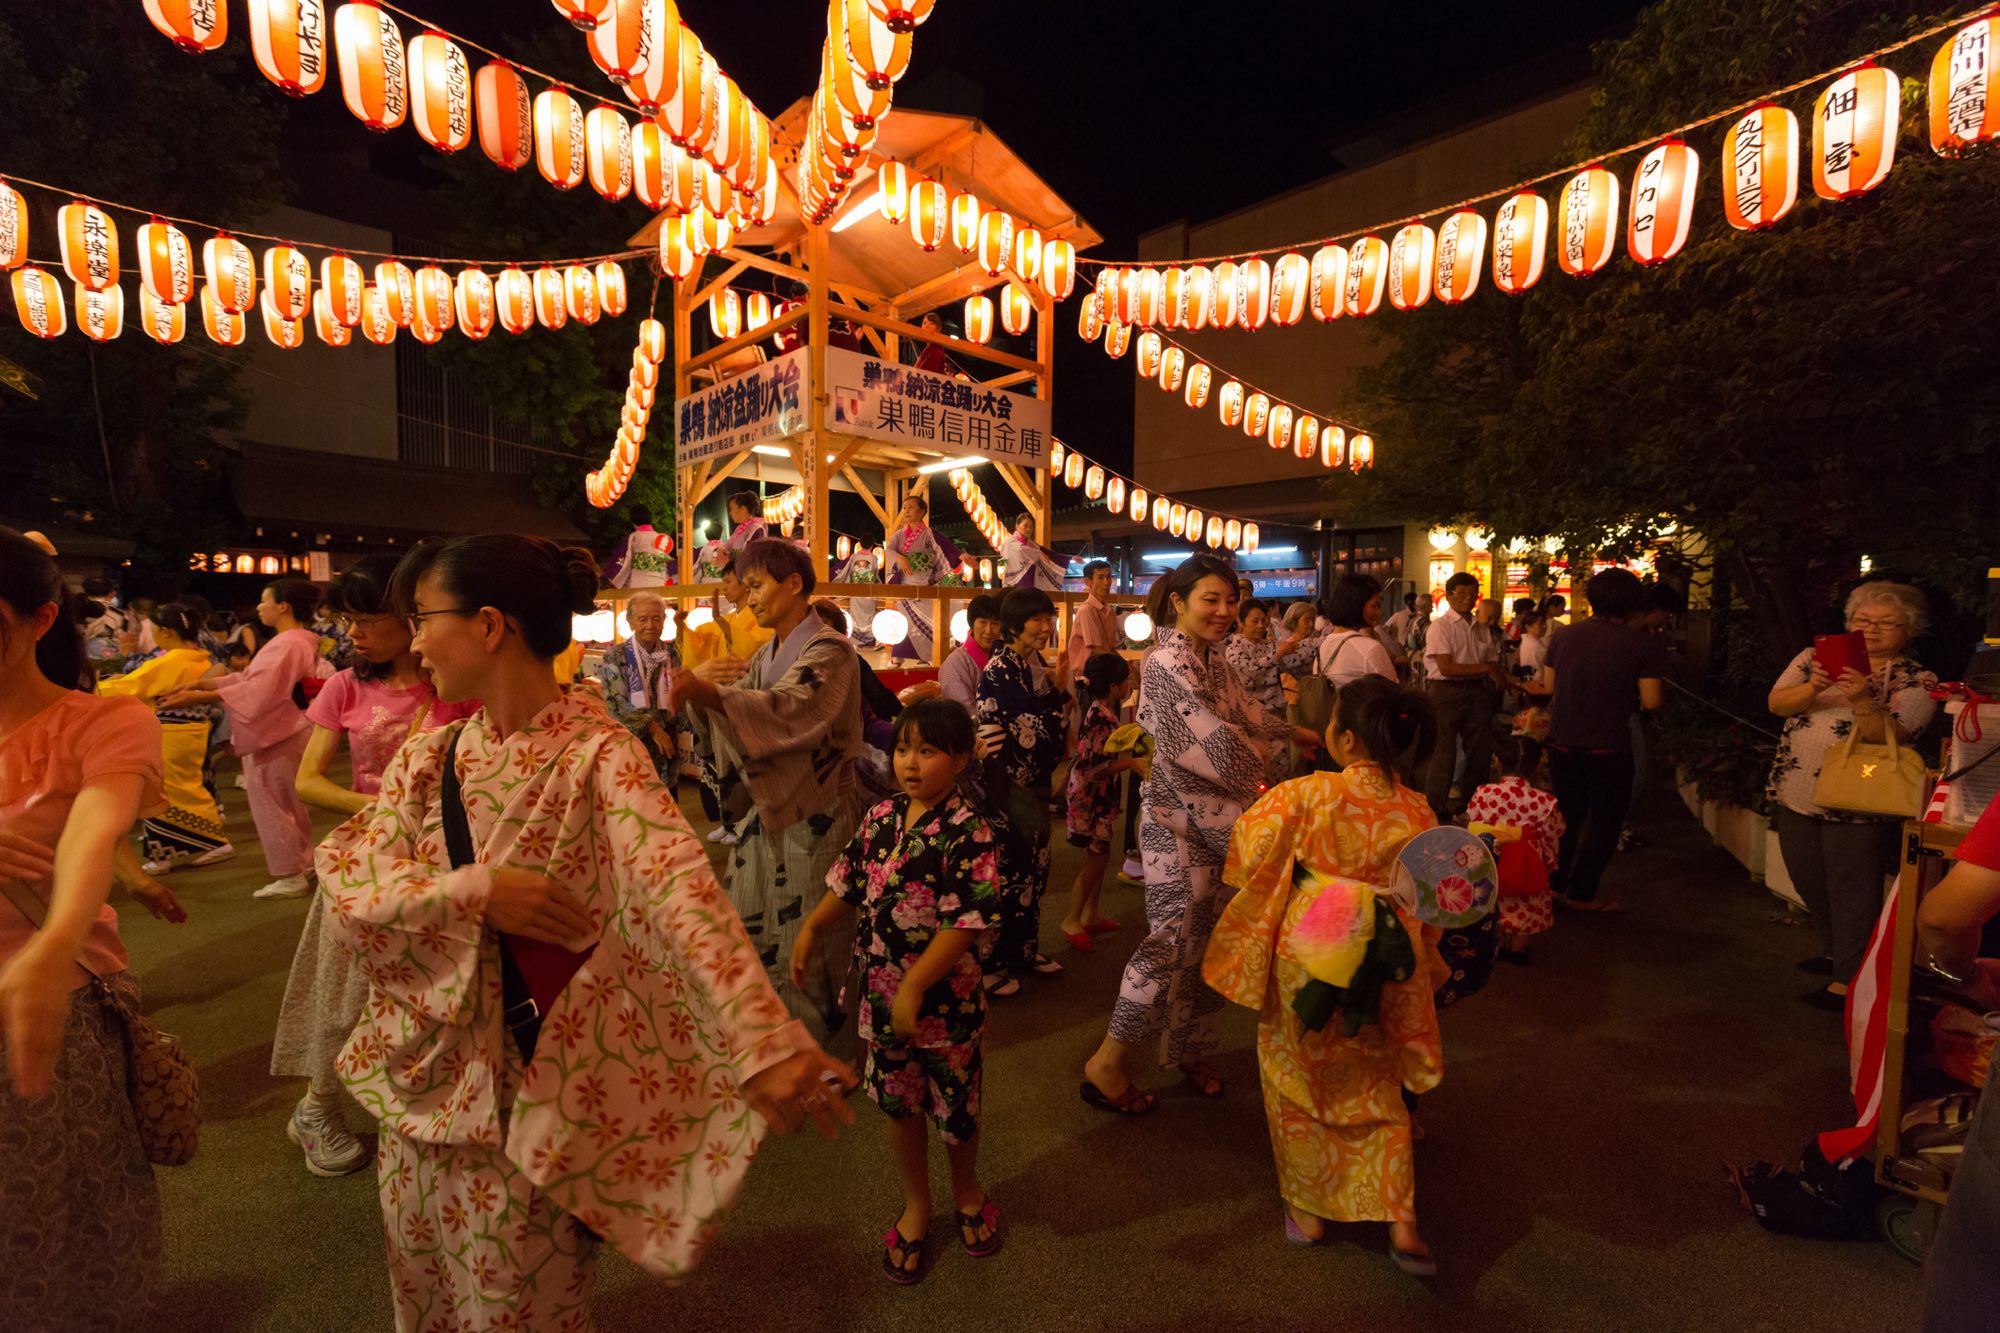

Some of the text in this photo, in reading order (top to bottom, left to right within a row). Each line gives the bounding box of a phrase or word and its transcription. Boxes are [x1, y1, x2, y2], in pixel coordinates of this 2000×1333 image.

[1633, 159, 1661, 232] タカセ
[876, 395, 1042, 459] 巣鴨信用金庫
